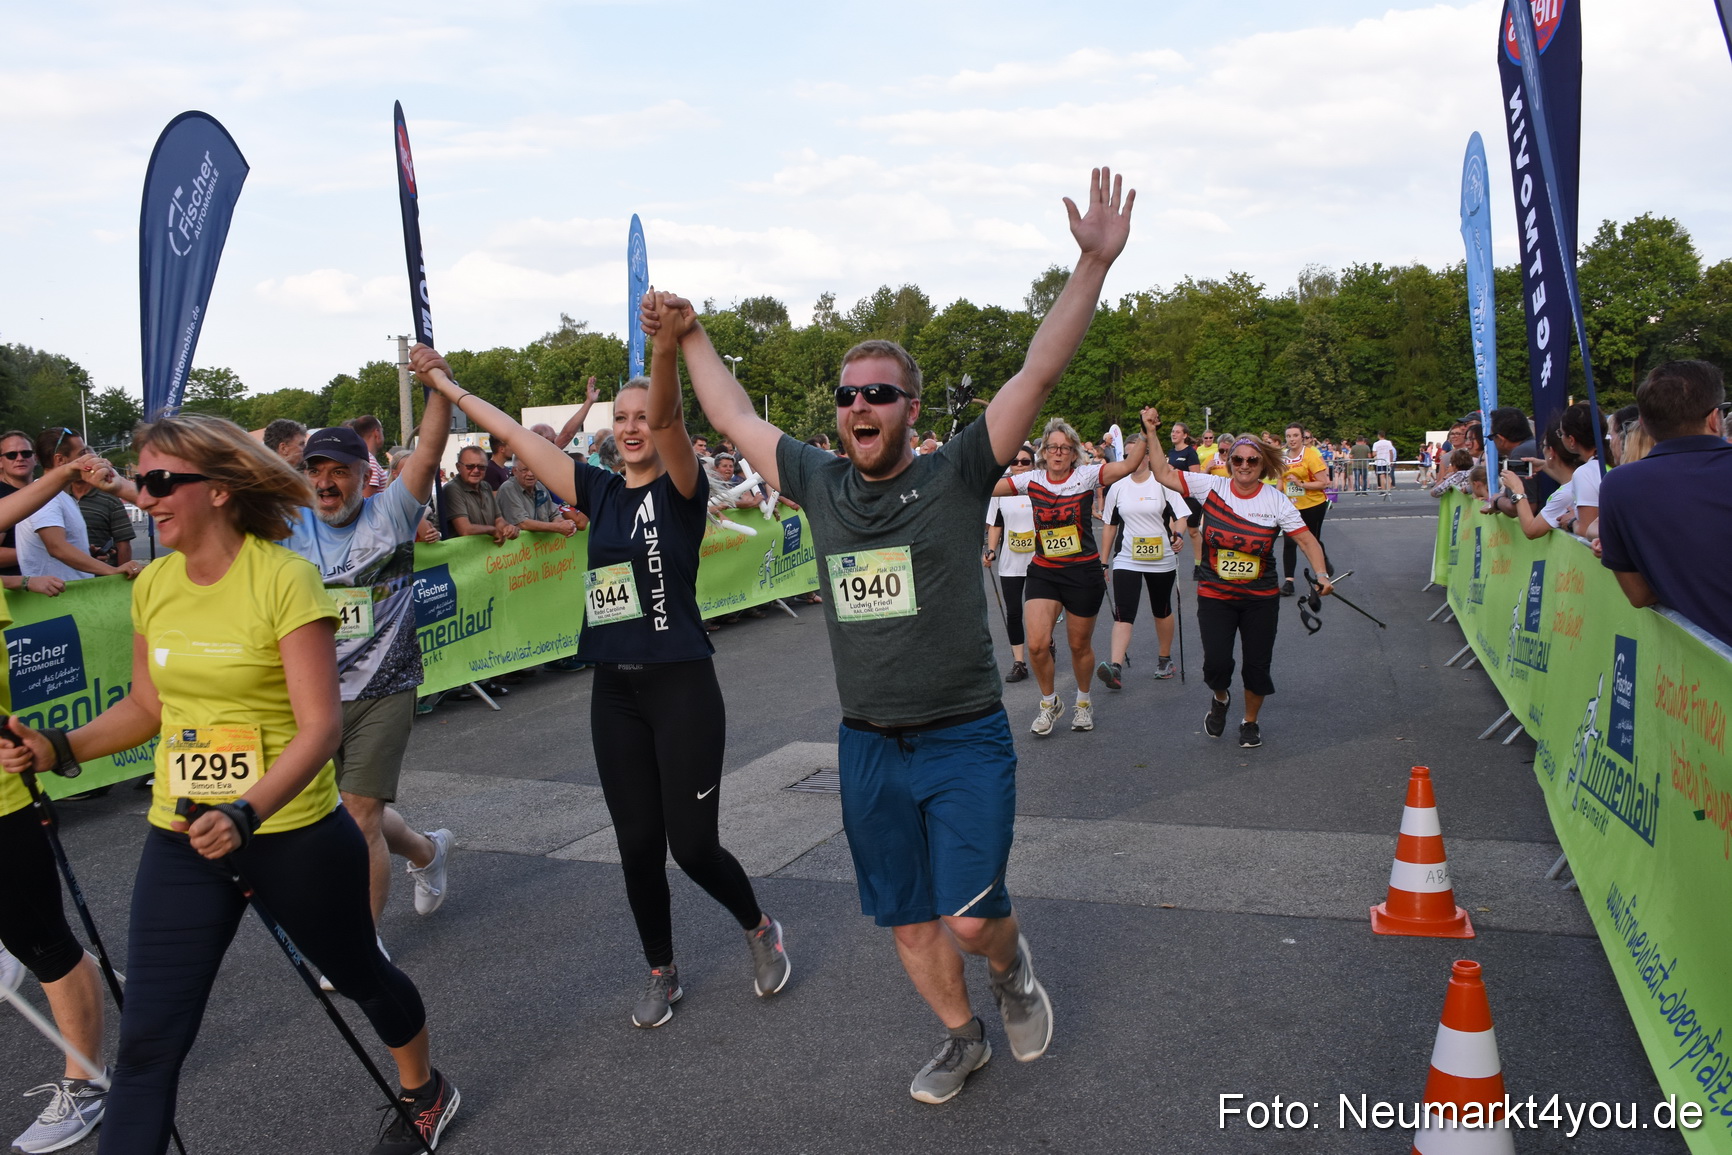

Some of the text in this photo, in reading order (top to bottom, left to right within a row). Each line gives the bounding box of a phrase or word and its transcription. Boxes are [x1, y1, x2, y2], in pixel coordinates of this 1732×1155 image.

[178, 150, 213, 241] Fischer
[193, 168, 220, 240] AUTOMOBILE
[1010, 538, 1033, 547] 2382
[1045, 536, 1074, 550] 2261
[1135, 544, 1160, 554] 2381
[486, 542, 532, 575] Gesunde
[1221, 560, 1254, 573] 2252
[417, 582, 449, 600] Fischer
[643, 526, 669, 632] RAIL.ONE
[839, 572, 902, 602] 1940
[589, 583, 630, 610] 1944
[849, 601, 873, 610] Ludwig
[8, 643, 69, 670] Fischer
[15, 656, 66, 677] AUTOMOBILE
[1616, 673, 1633, 697] Fischer
[175, 752, 250, 781] 1295
[191, 782, 216, 790] Simon
[1585, 730, 1661, 844] firmenlauf
